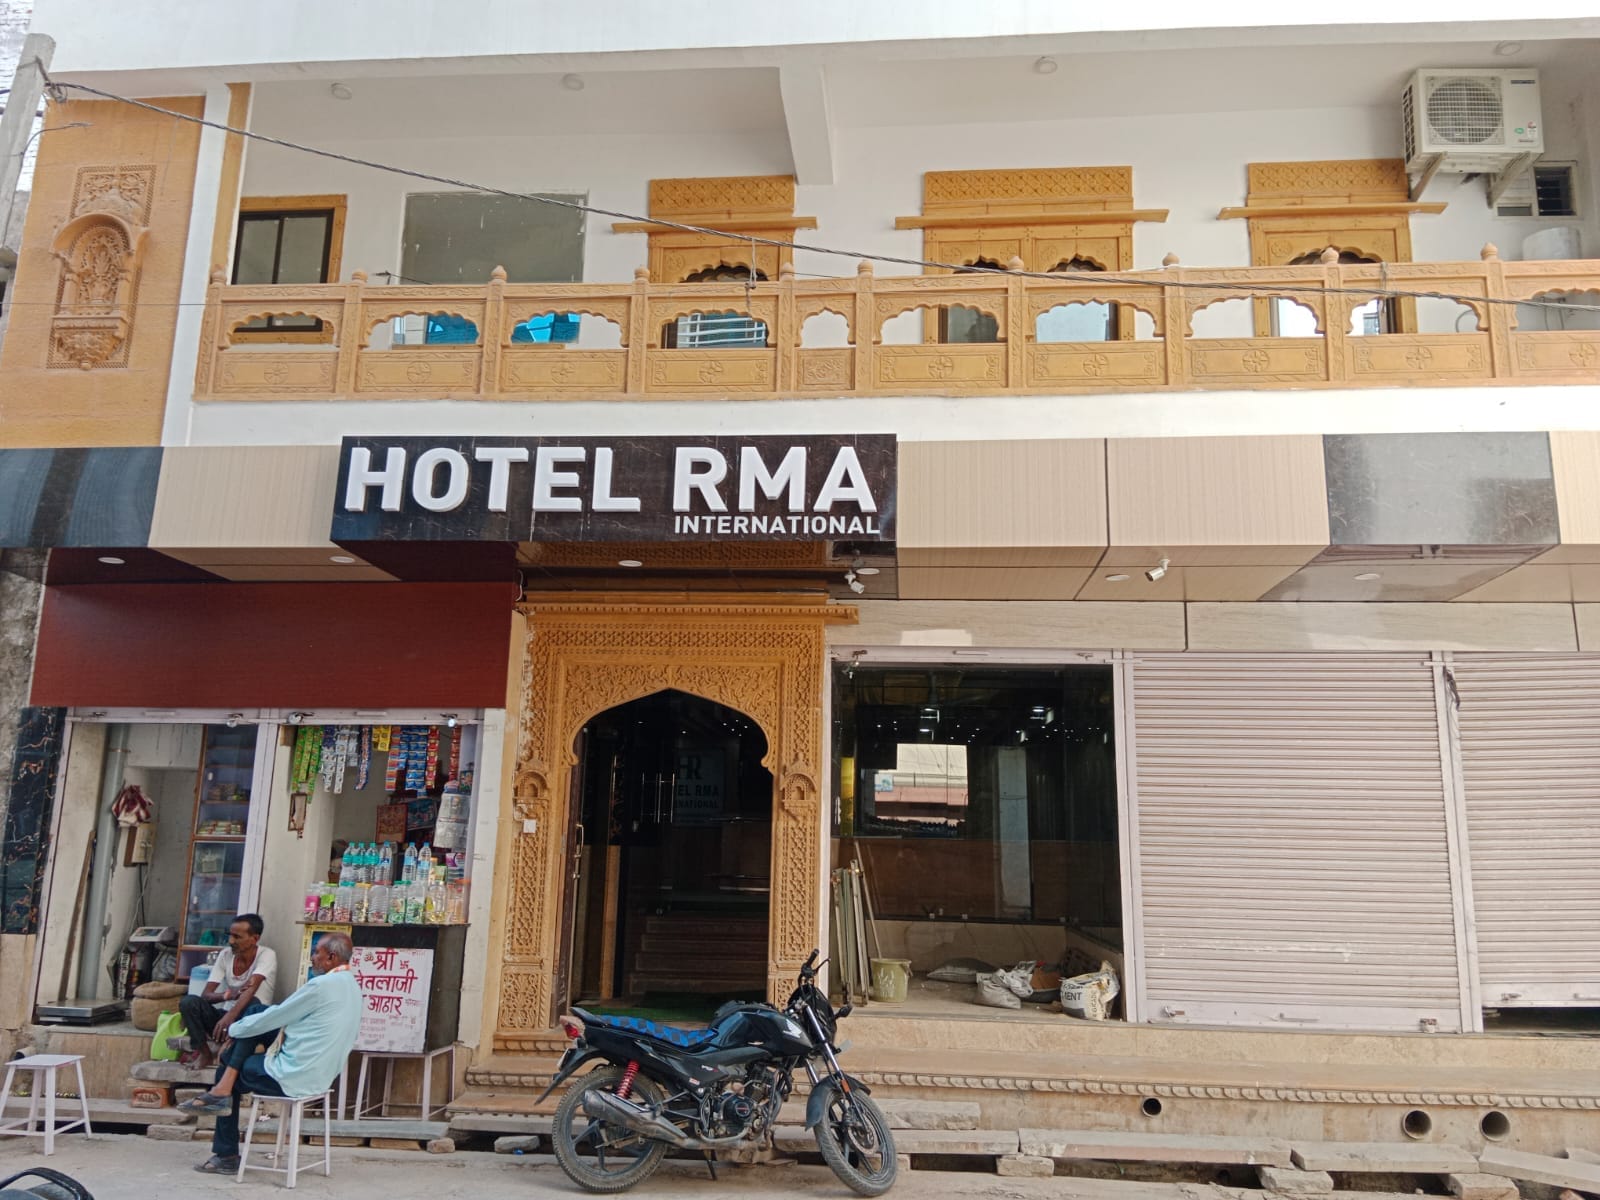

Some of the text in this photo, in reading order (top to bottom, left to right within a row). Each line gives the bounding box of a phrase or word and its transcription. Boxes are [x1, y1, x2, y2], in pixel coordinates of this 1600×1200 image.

[345, 446, 878, 513] HOTEL RMA
[674, 515, 881, 535] INTERNATIONAL
[372, 946, 399, 972] श्री
[367, 994, 404, 1016] आहार
